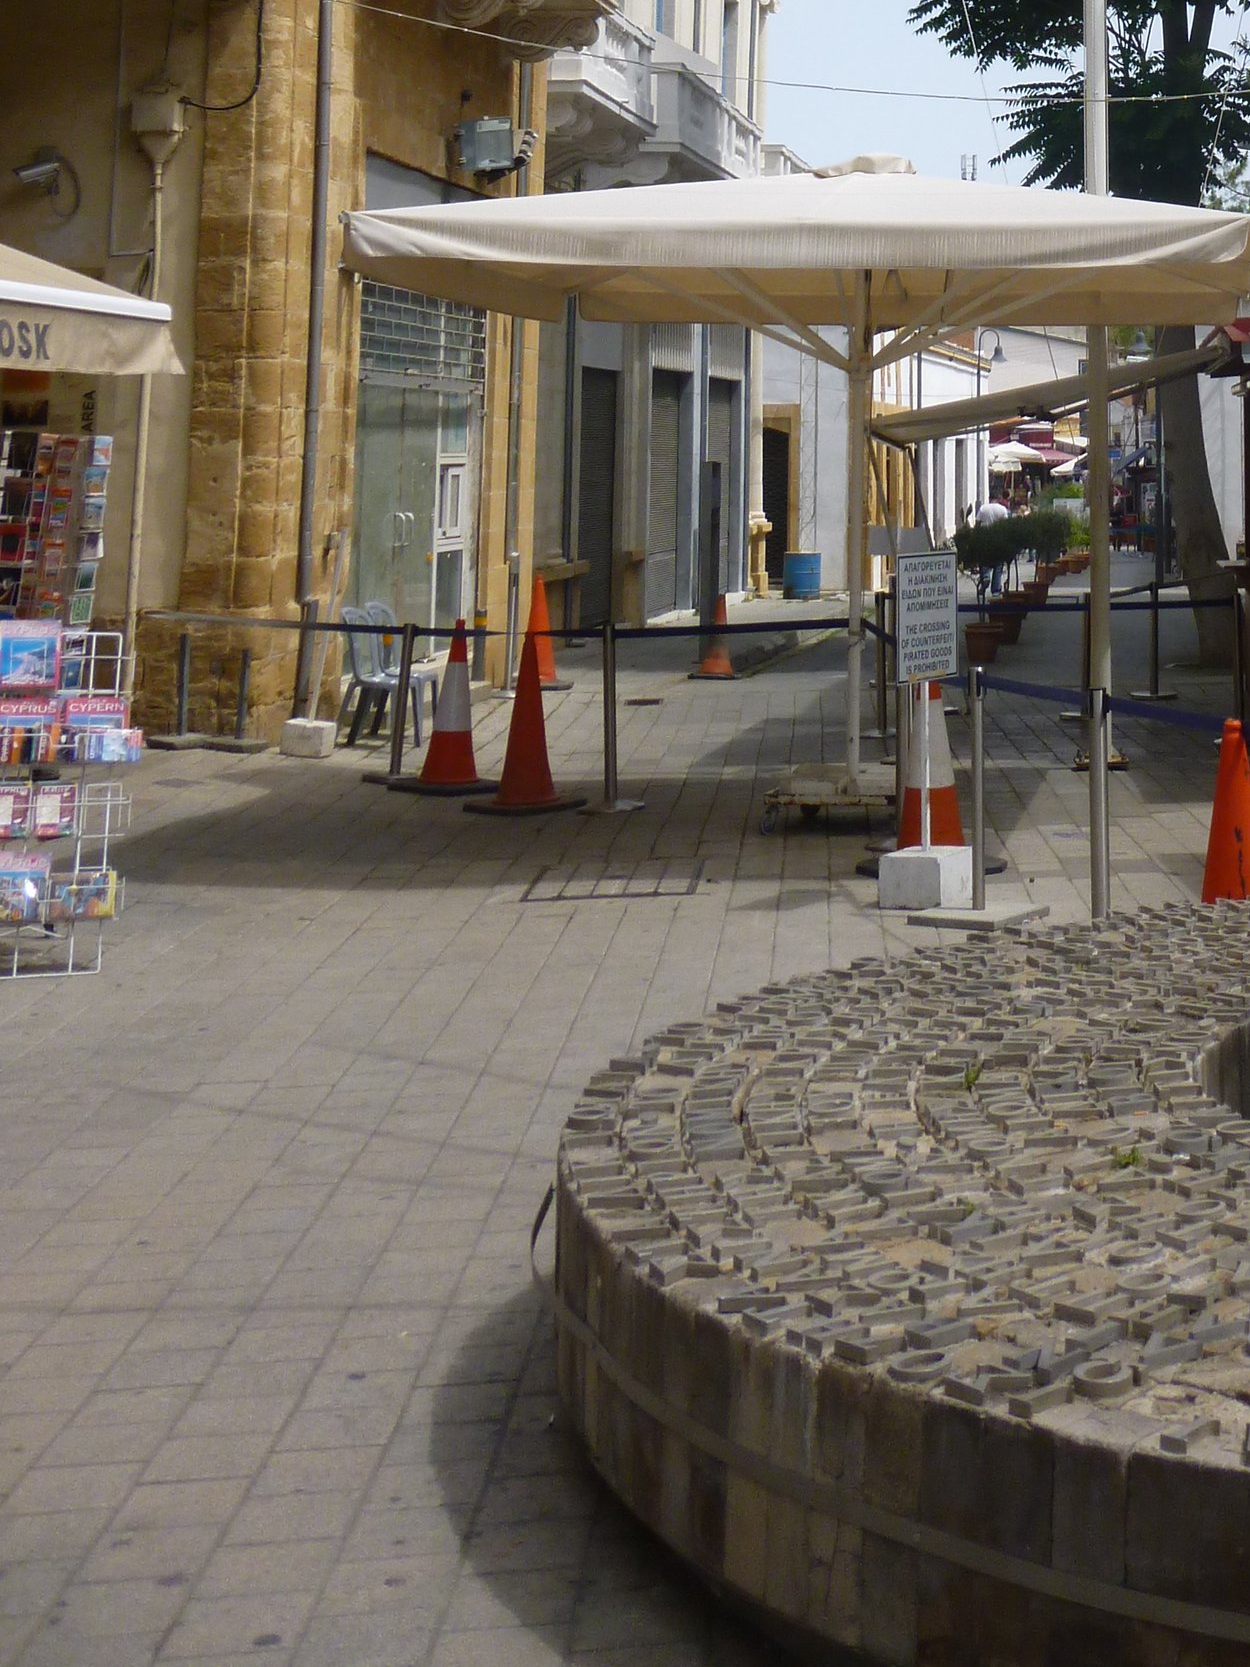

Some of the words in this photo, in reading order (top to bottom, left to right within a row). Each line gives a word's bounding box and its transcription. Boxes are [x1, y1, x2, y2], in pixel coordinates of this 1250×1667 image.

[81, 389, 97, 432] AREA
[903, 559, 951, 573] ΑΠΑΓΟΡΕΥΕΤΑΙ
[922, 587, 936, 597] ΠΟΥ
[937, 585, 954, 596] ΕΙΝΑΙ
[905, 625, 917, 635] THE
[919, 620, 950, 633] CROSSING
[901, 639, 910, 649] OF
[903, 651, 929, 662] PIRATED
[930, 646, 952, 658] GOODS
[906, 664, 912, 675] IS
[913, 659, 950, 674] PROHIBITED
[0, 701, 57, 714] CYPRUS
[69, 701, 125, 712] CYPERN
